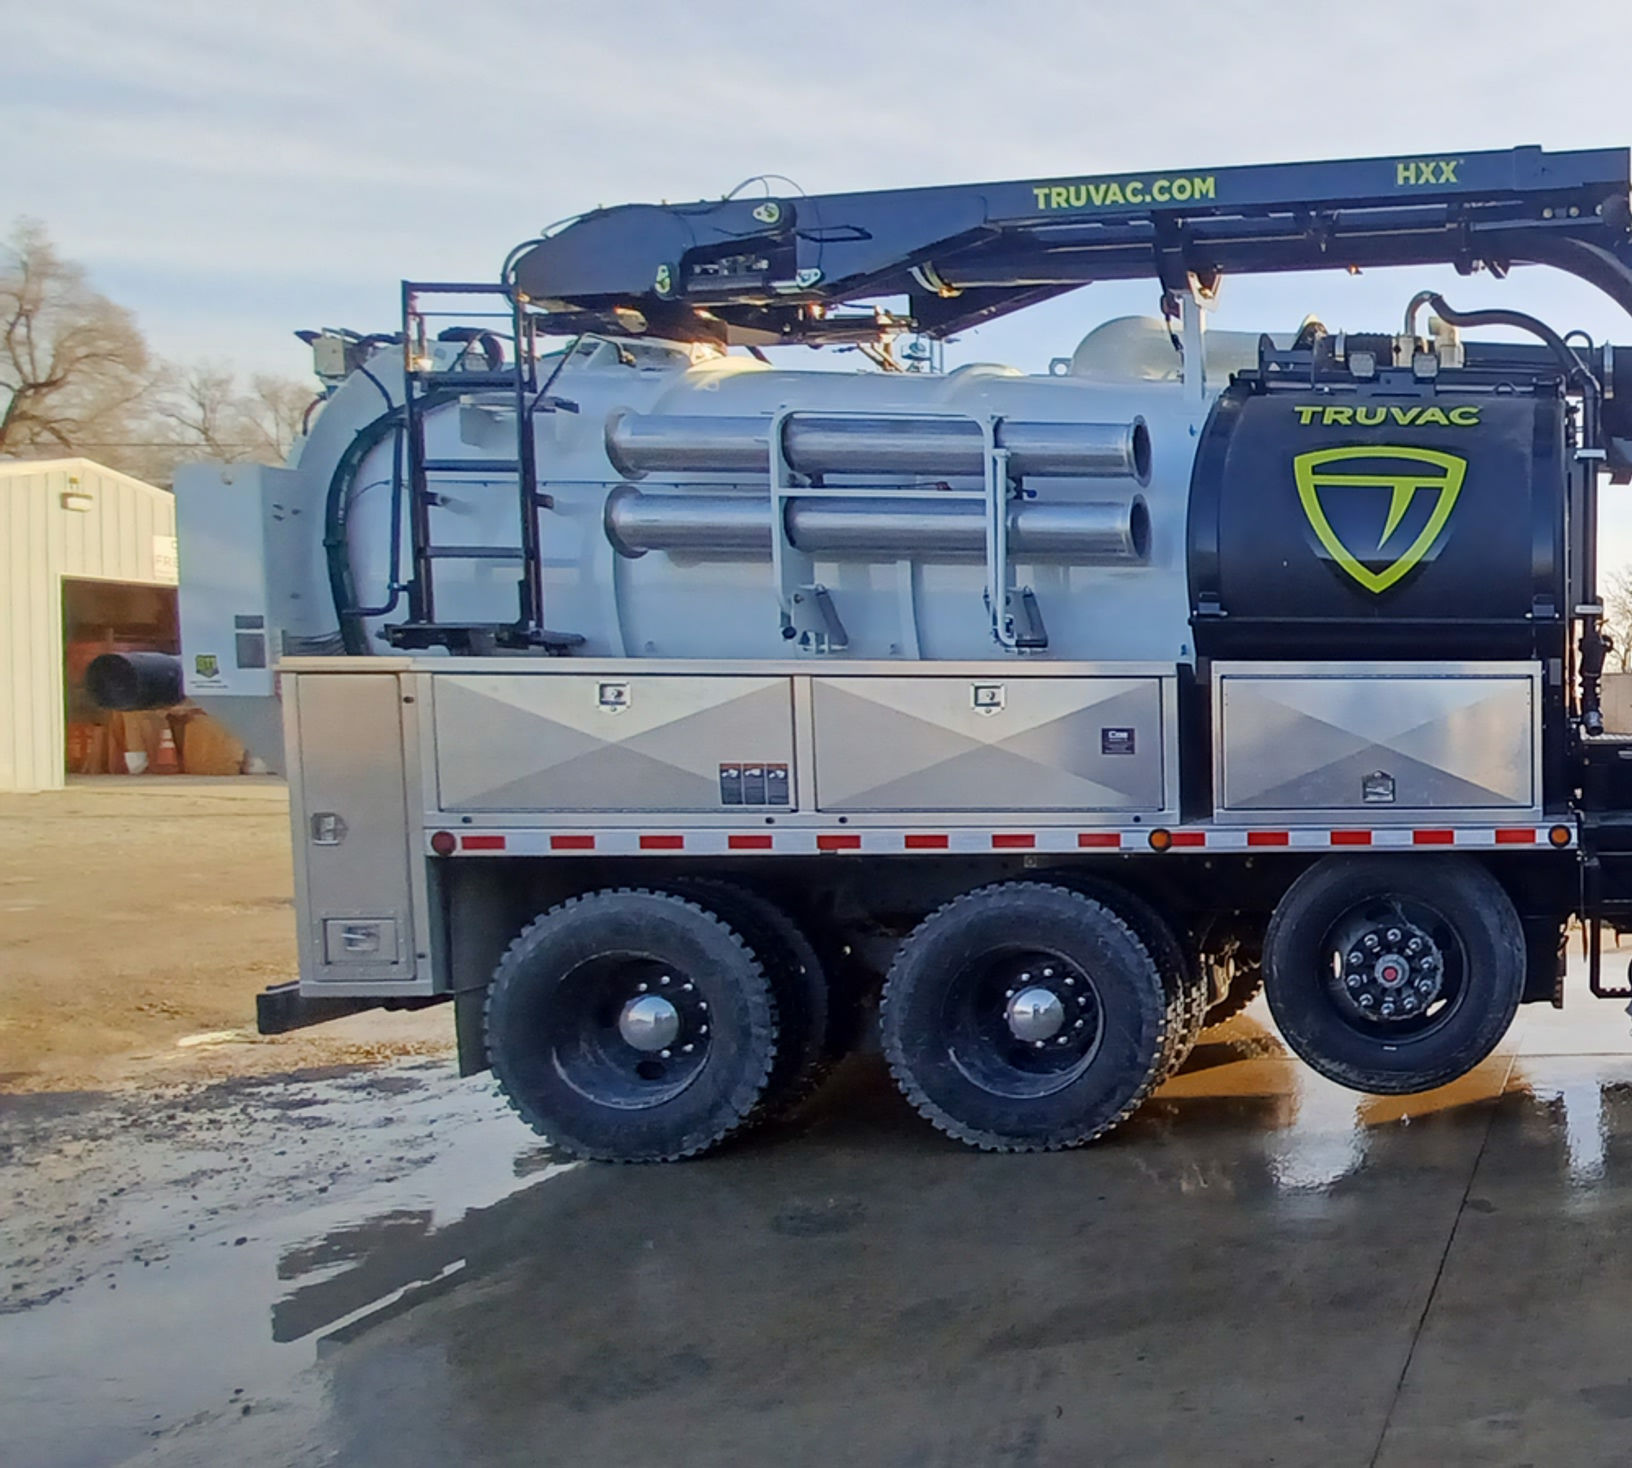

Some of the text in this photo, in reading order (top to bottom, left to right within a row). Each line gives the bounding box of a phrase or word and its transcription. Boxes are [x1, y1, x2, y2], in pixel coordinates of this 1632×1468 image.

[1397, 161, 1458, 185] HXX
[1033, 176, 1216, 210] TRUVAC.COM
[1294, 406, 1481, 425] TRUVAC
